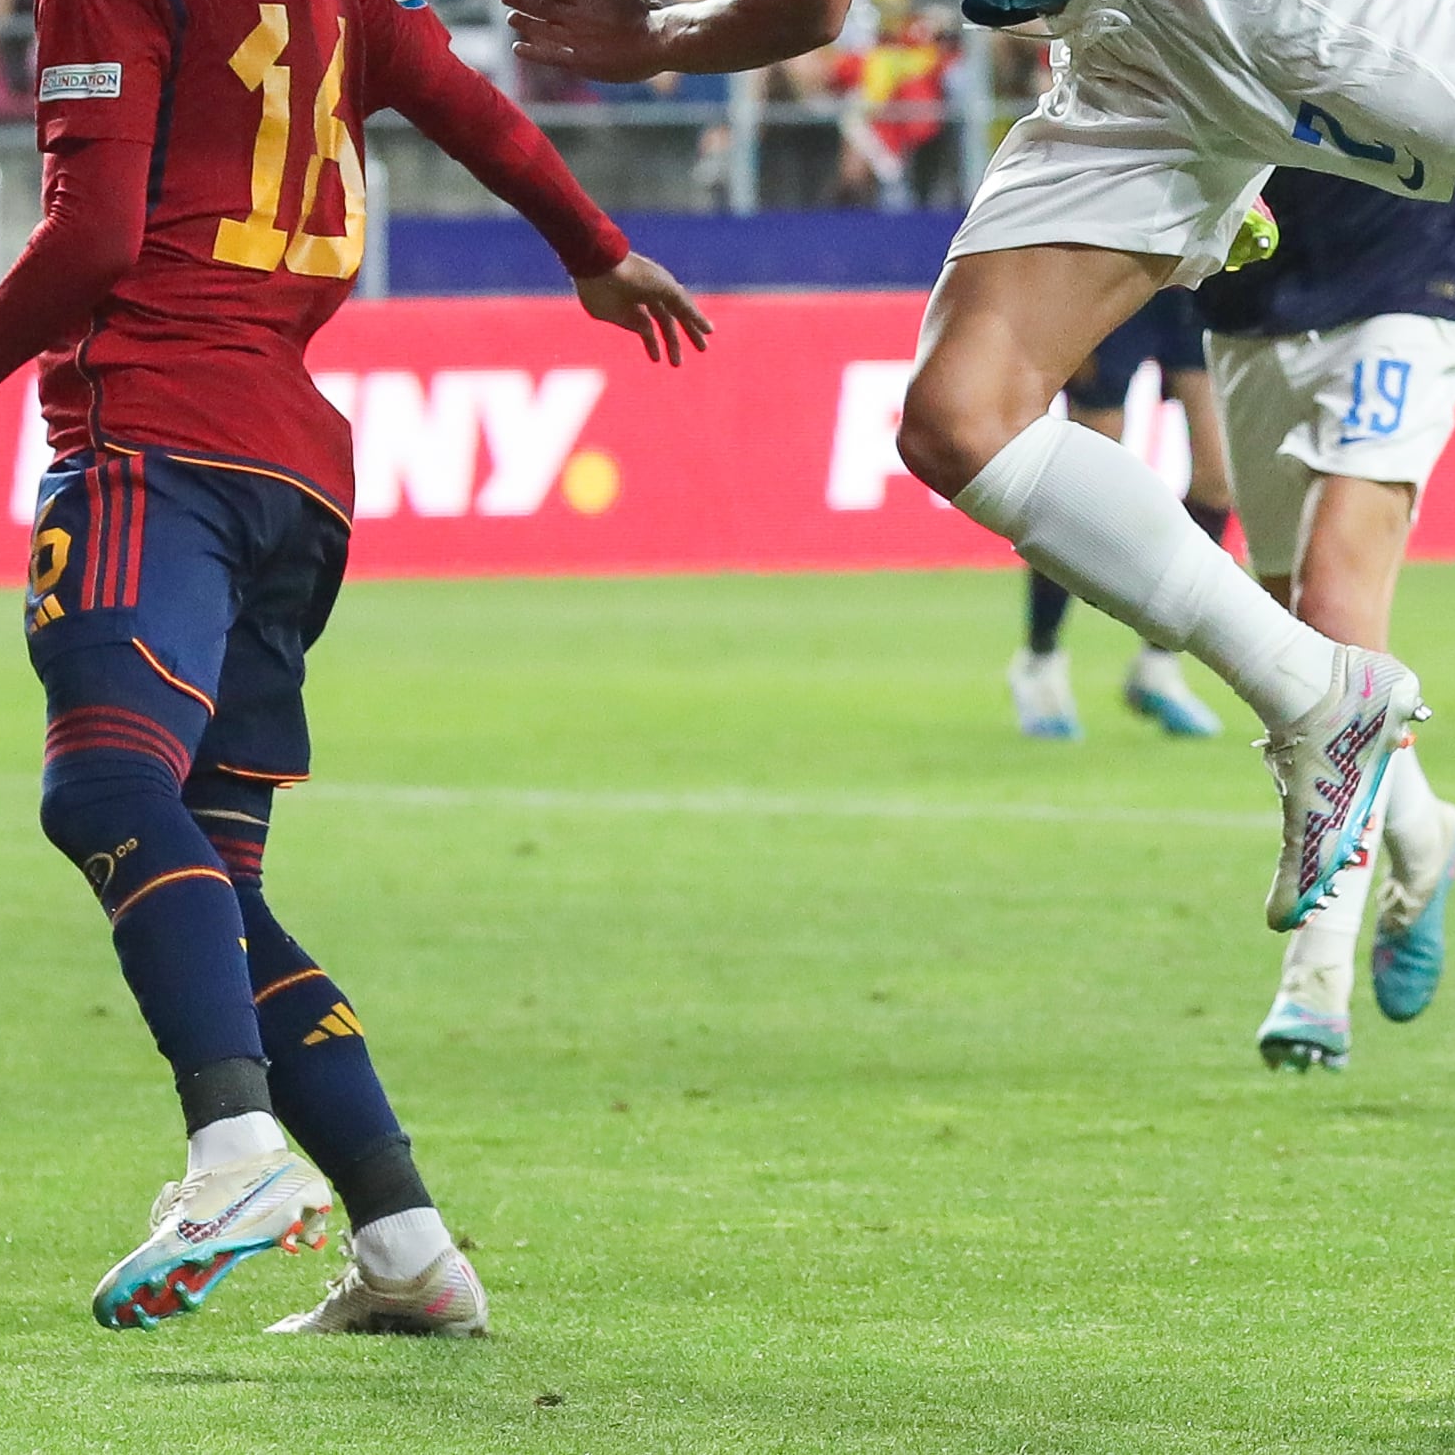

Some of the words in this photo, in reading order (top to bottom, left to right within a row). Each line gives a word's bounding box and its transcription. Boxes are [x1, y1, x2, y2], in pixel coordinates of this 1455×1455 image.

[212, 3, 366, 281] 16
[1292, 99, 1395, 166] 7
[1341, 358, 1412, 434] 19
